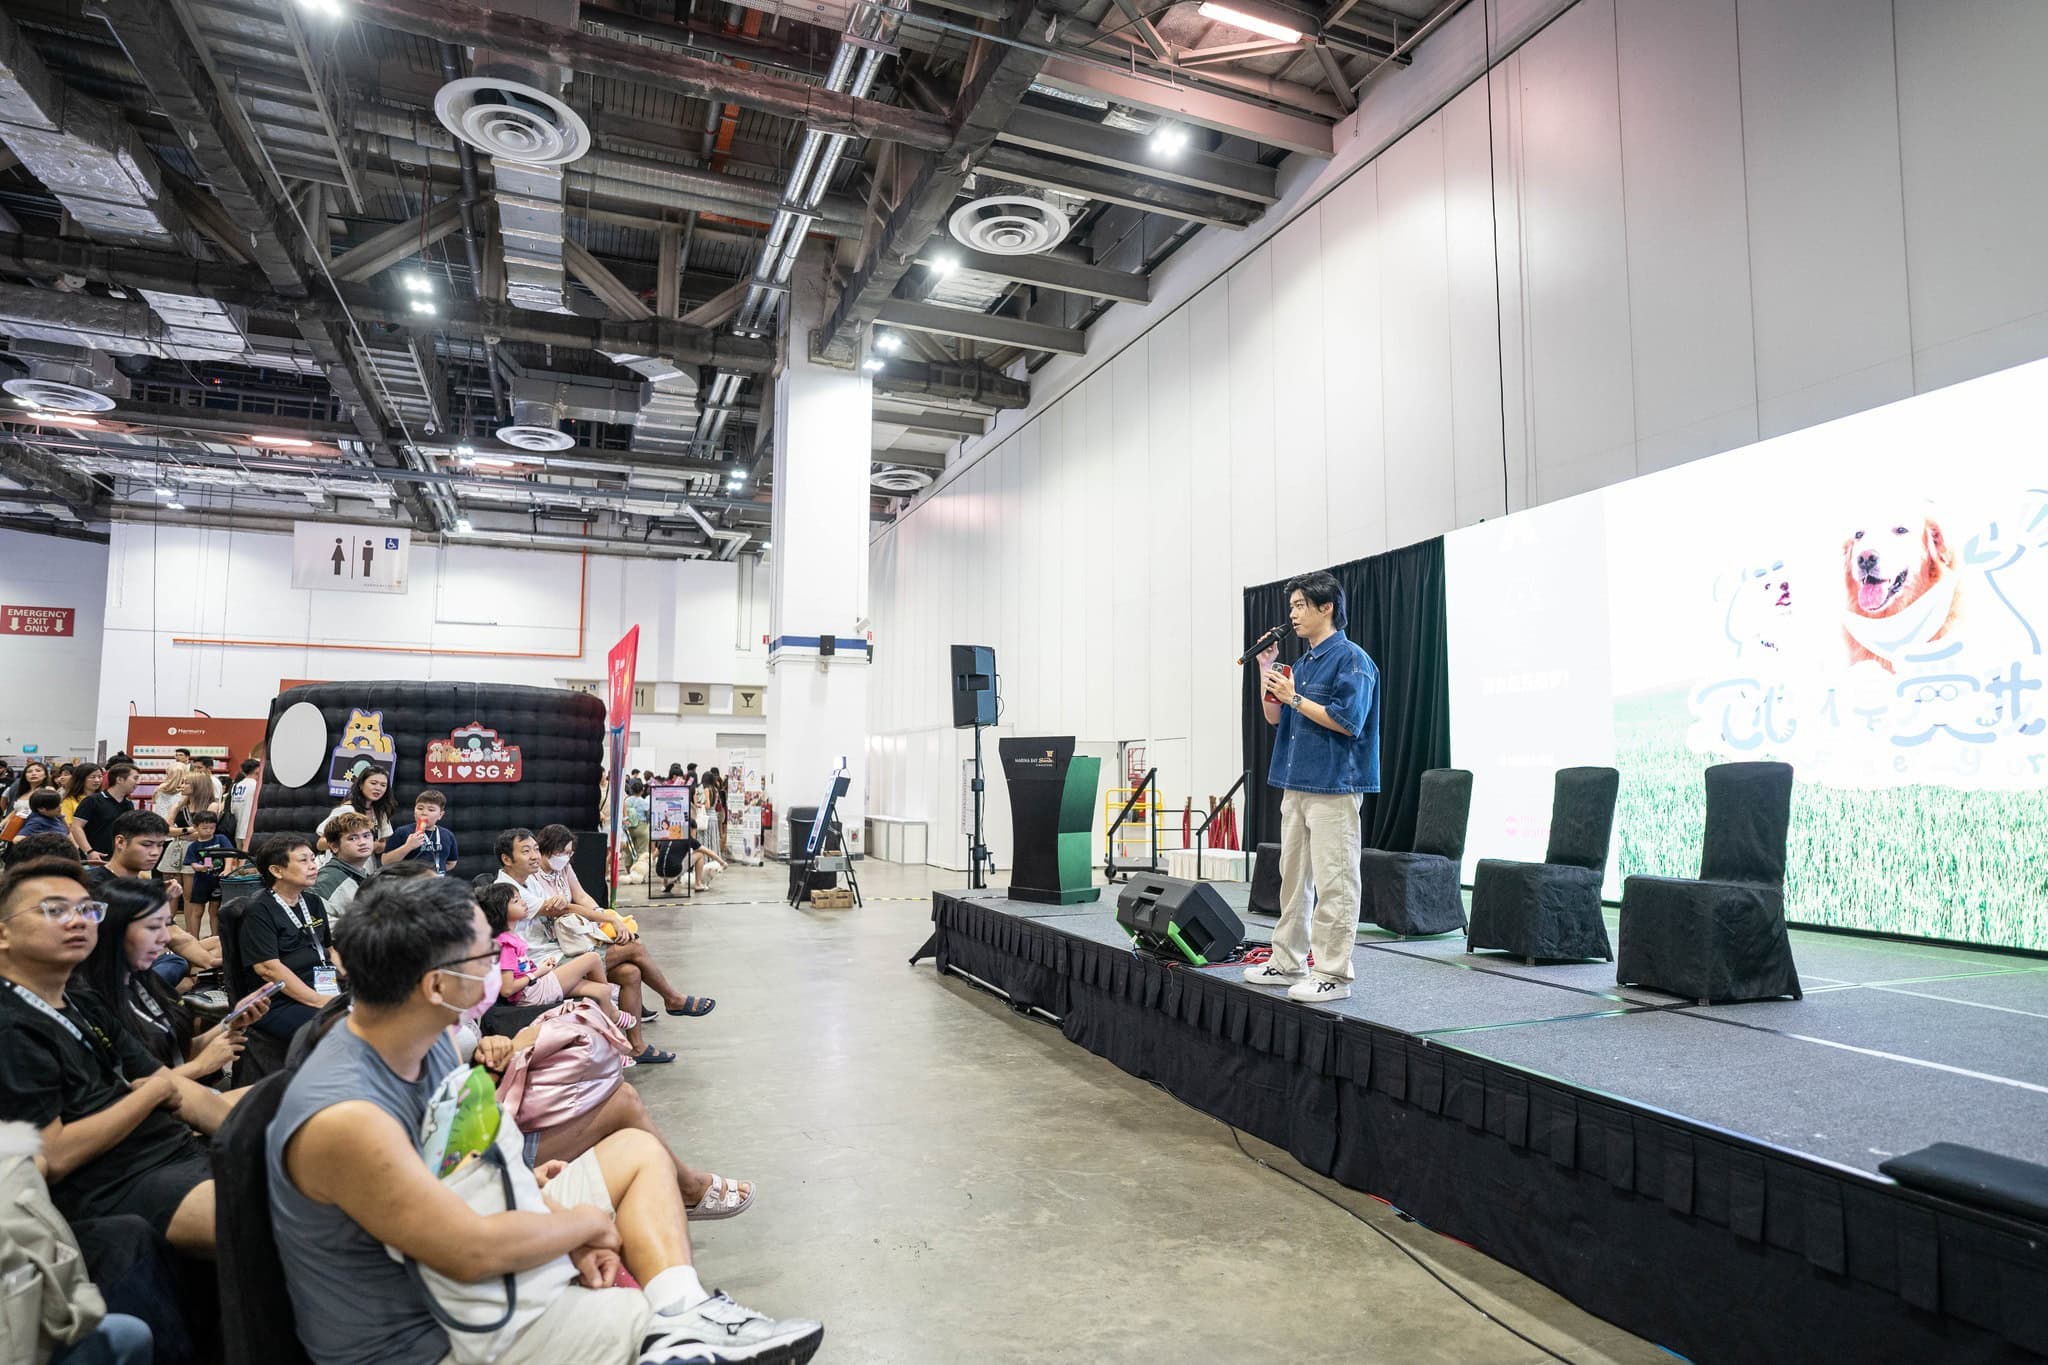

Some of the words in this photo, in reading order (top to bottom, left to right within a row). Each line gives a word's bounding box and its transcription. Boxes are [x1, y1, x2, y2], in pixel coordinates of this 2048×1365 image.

[8, 609, 67, 618] EMERGENCY
[24, 625, 50, 633] ONLY
[447, 765, 453, 778] I
[475, 765, 500, 778] SG
